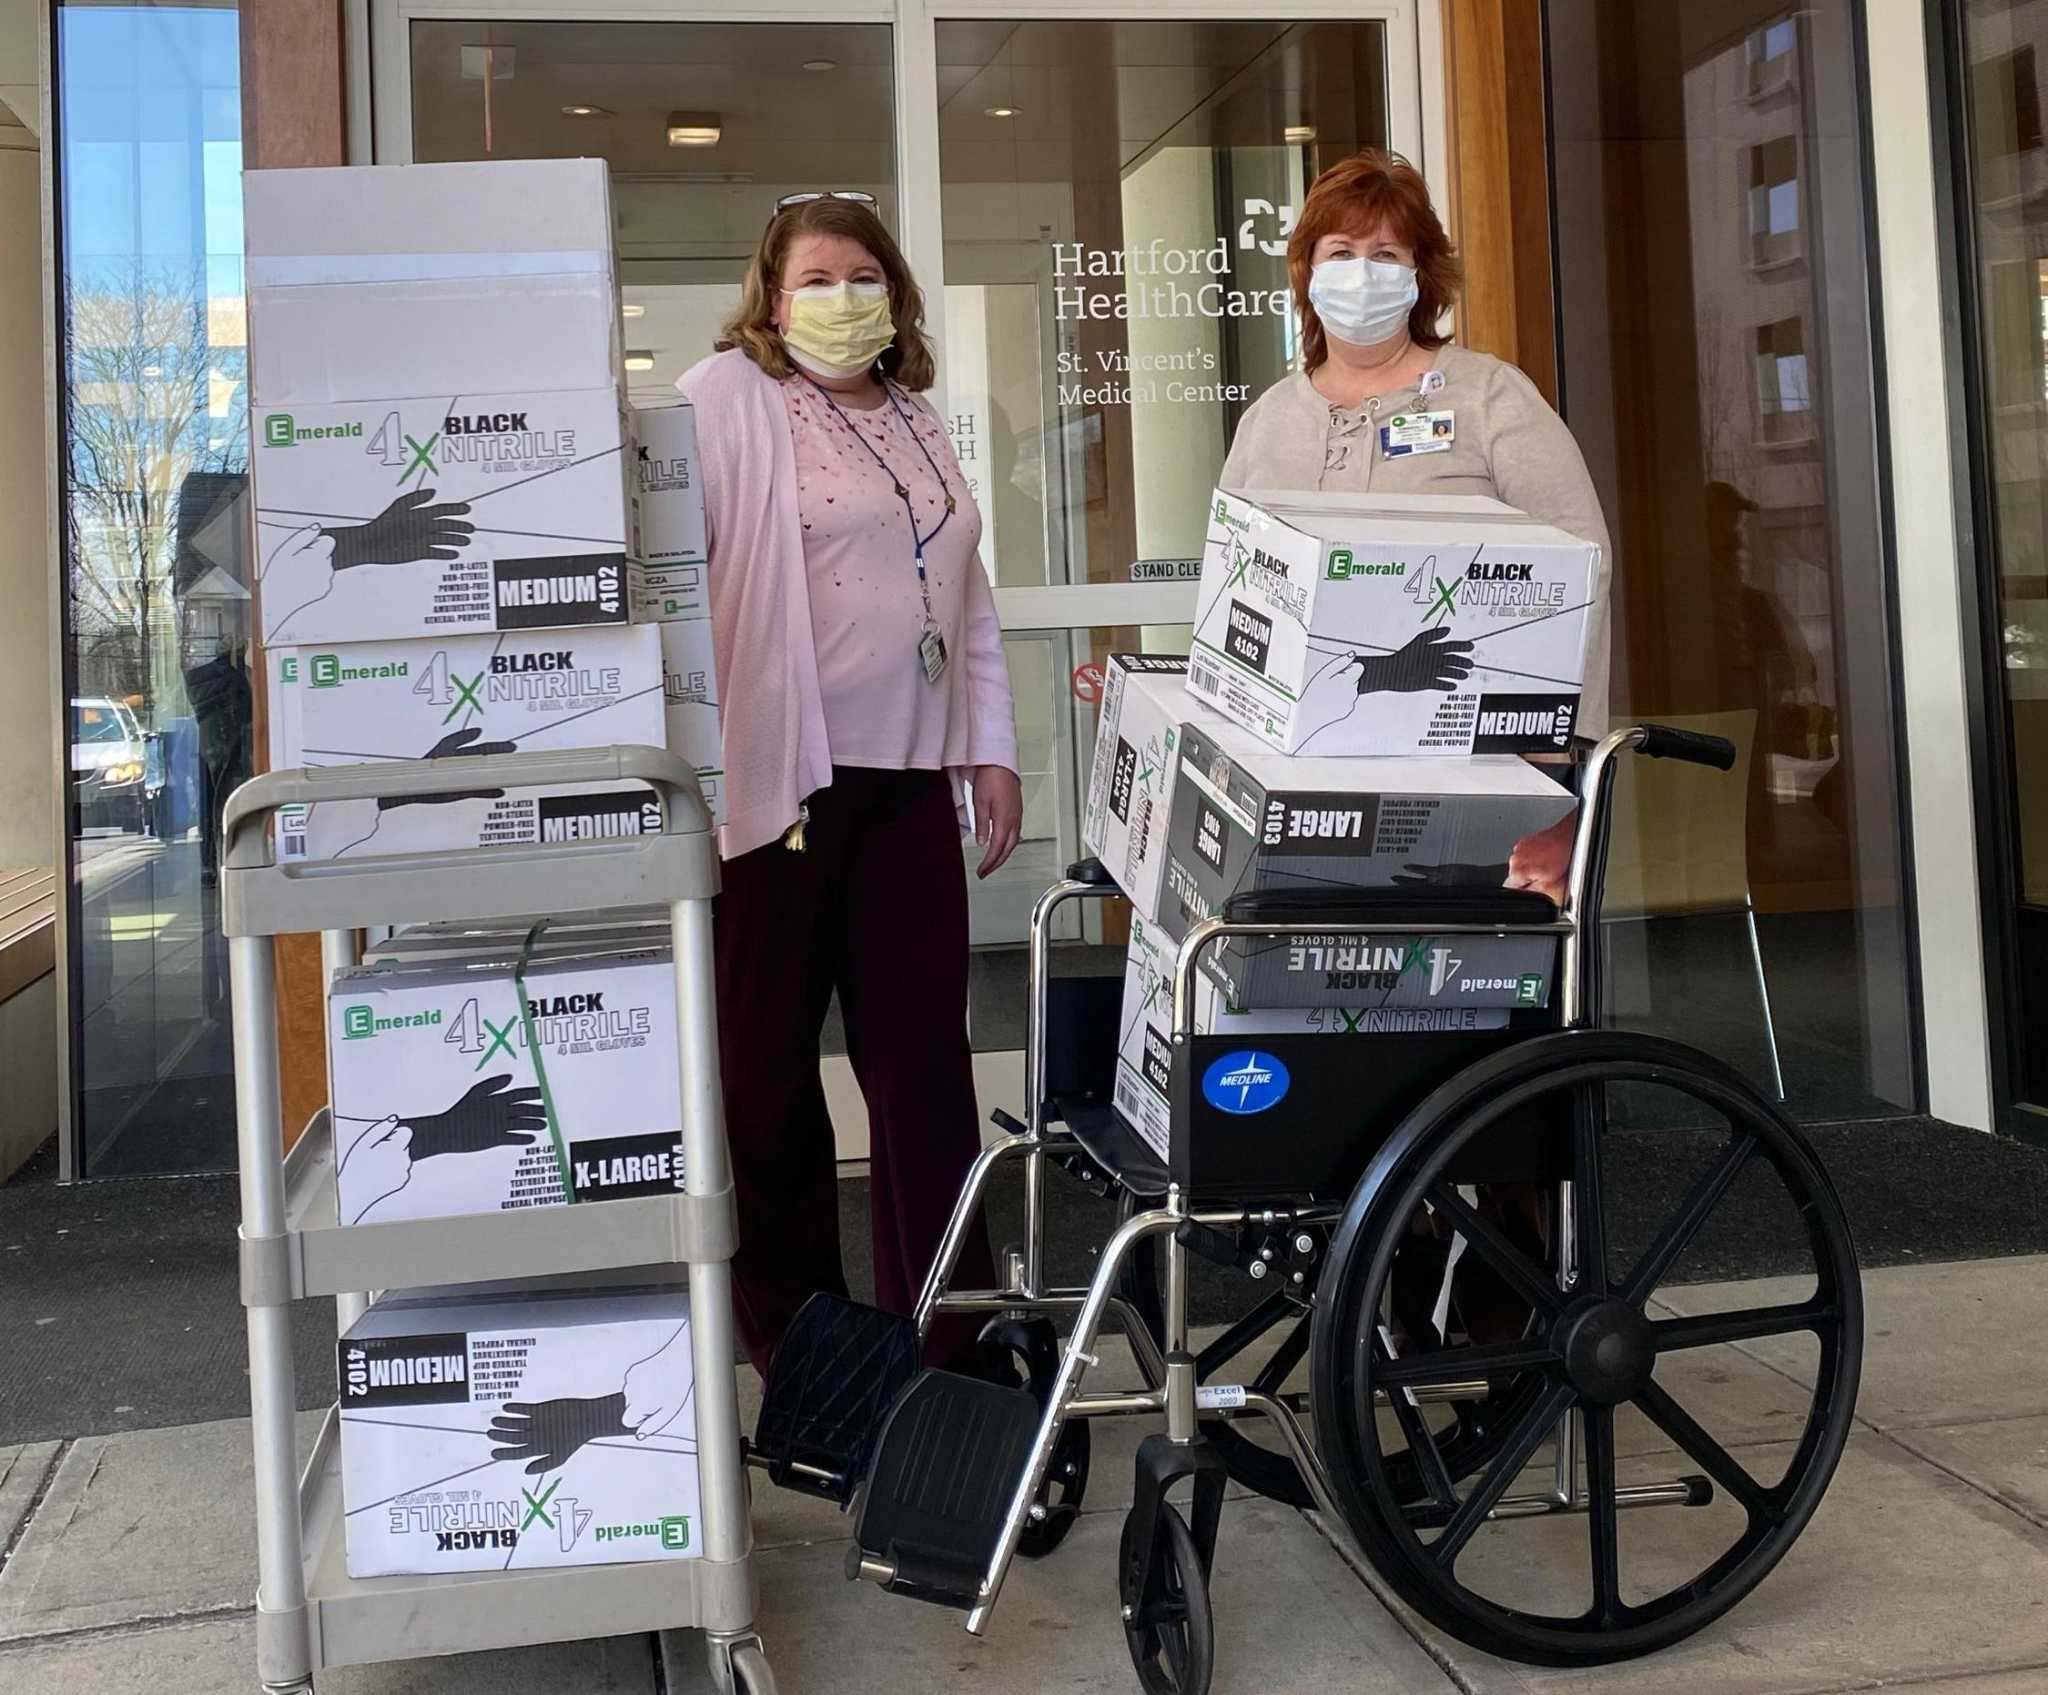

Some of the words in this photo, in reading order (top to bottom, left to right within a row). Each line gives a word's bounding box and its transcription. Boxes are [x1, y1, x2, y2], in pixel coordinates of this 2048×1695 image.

[1052, 238, 1231, 277] Hartford
[1054, 282, 1289, 320] HealthCare
[1057, 352, 1089, 373] St.
[1096, 348, 1216, 373] Vincent's
[1058, 382, 1157, 406] Medical
[1166, 382, 1250, 402] Center
[265, 414, 363, 447] Emerald
[444, 412, 529, 436] BLACK
[441, 430, 577, 464] NITRILE
[1134, 564, 1174, 578] STAND
[1253, 547, 1290, 579] BLACK
[1326, 549, 1406, 580] Emerald
[1467, 563, 1534, 581] BLACK
[498, 575, 597, 607] MEDIUM
[597, 565, 620, 614] 4102
[1249, 564, 1308, 613] NITRILE
[1461, 582, 1567, 606] NITRILE
[1230, 606, 1271, 646] MEDIUM
[490, 651, 574, 674] BLACK
[1234, 635, 1259, 662] 4102
[311, 655, 408, 688] Emerald
[488, 668, 621, 702] NITRILE
[1478, 711, 1555, 736] MEDIUM
[1552, 704, 1573, 746] 4102
[543, 811, 640, 844] MEDIUM
[641, 802, 662, 834] 102
[1263, 800, 1286, 845] 4103
[1288, 809, 1364, 838] LARGE
[1198, 827, 1222, 865] LARGE
[1290, 937, 1335, 945] GLOVES
[1338, 937, 1358, 945] MIL
[1287, 947, 1405, 972] NITRILE
[1326, 972, 1399, 990] BLACK
[1461, 973, 1544, 1008] Emerald
[526, 992, 605, 1019] BLACK
[1368, 1008, 1477, 1032] NITRILE
[343, 1005, 442, 1041] Emerald
[1145, 1029, 1172, 1071] MEDIU
[1149, 1060, 1168, 1090] 4102
[1219, 1073, 1273, 1087] MEDLINE
[574, 1152, 671, 1189] X-LARGE
[346, 1349, 368, 1396] 4102
[369, 1354, 465, 1387] MEDIUM
[1214, 1386, 1240, 1395] Excel
[389, 1500, 520, 1534] NITRILE
[594, 1515, 692, 1550] Emerald
[436, 1529, 518, 1551] BLACK
